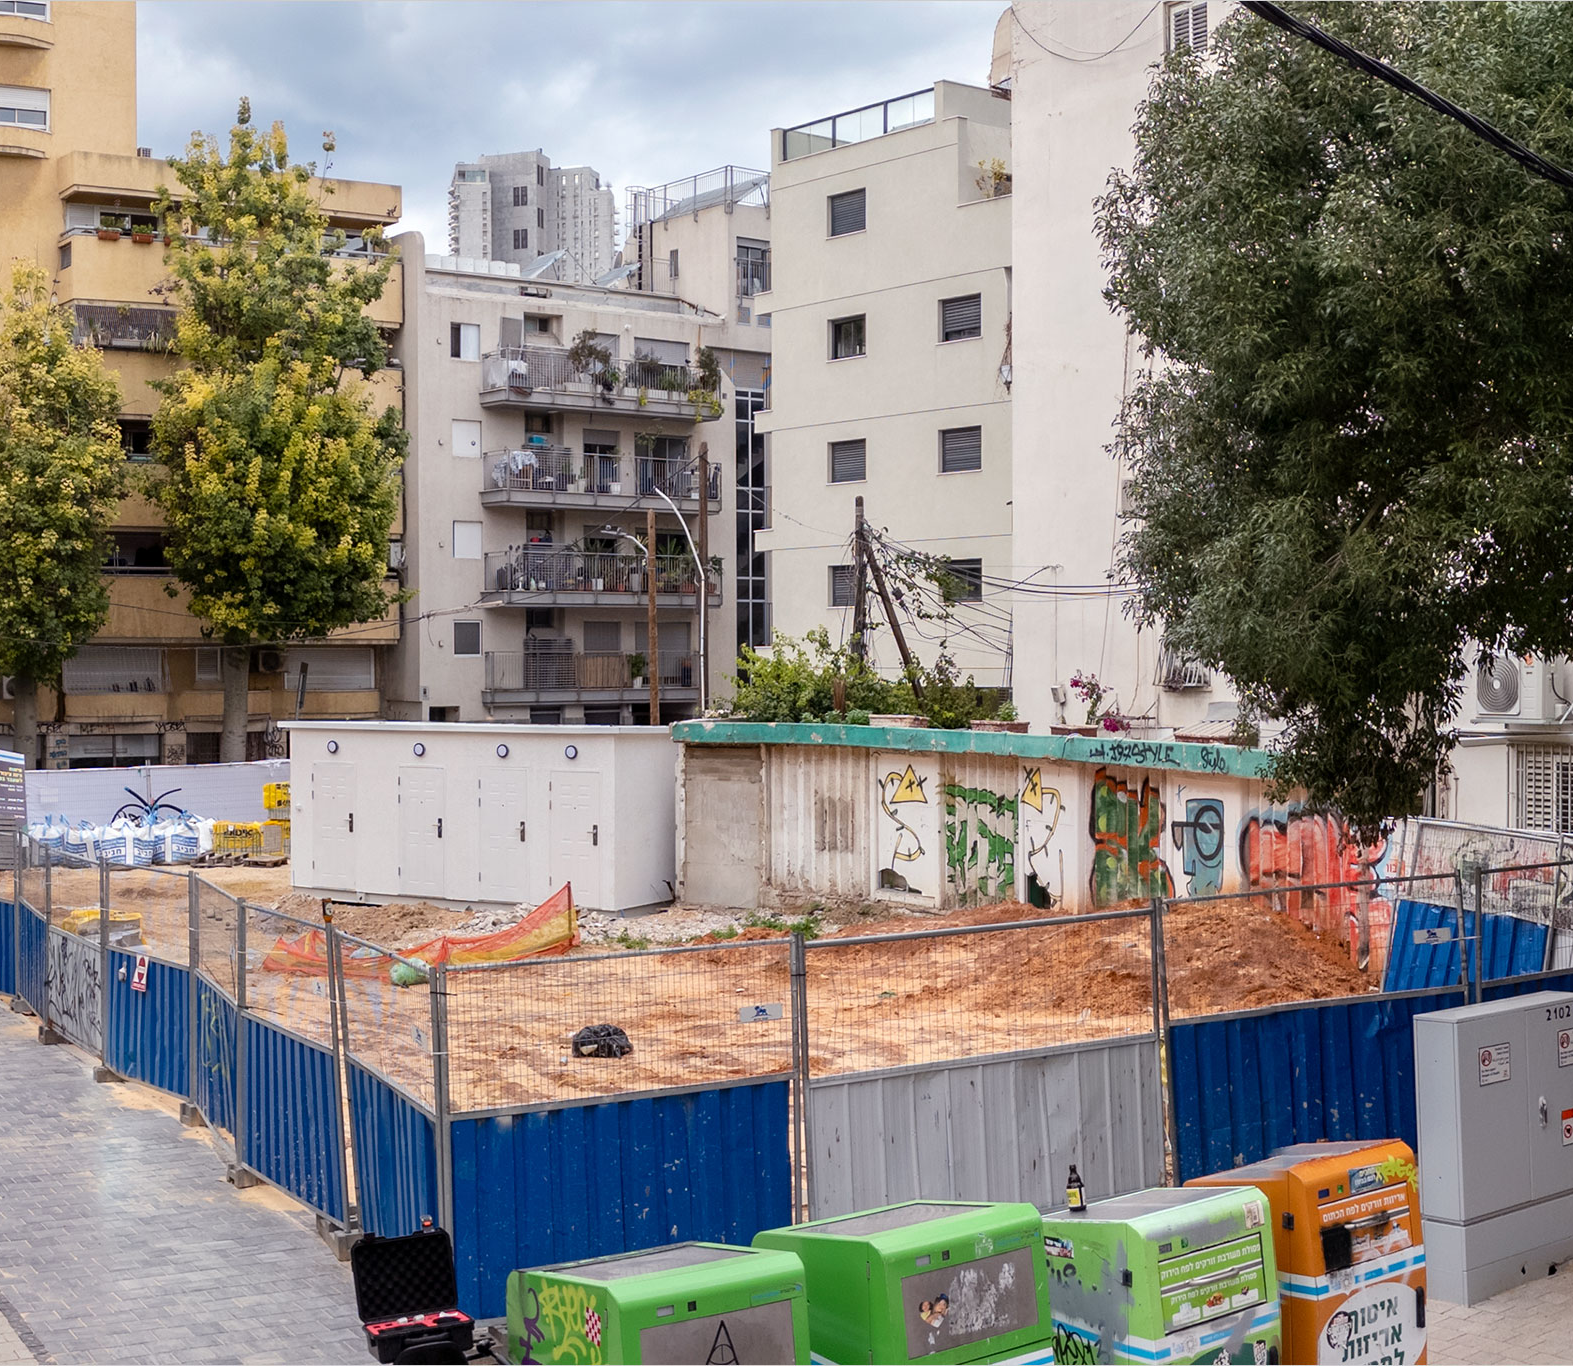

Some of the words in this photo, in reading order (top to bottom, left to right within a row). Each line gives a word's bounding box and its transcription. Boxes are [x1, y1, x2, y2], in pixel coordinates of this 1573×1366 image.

[104, 848, 122, 857] חביב
[175, 846, 195, 854] חביב
[1361, 1198, 1383, 1213] זורקים
[1383, 1192, 1406, 1207] אריזות
[1322, 1208, 1346, 1223] הכתום
[1217, 1249, 1241, 1263] מעורבת
[1242, 1243, 1261, 1256] פסולת
[1195, 1256, 1216, 1270] זורקים
[1160, 1267, 1180, 1281] הירוק
[1348, 1296, 1398, 1335] איסוף
[1342, 1323, 1402, 1362] אריזות
